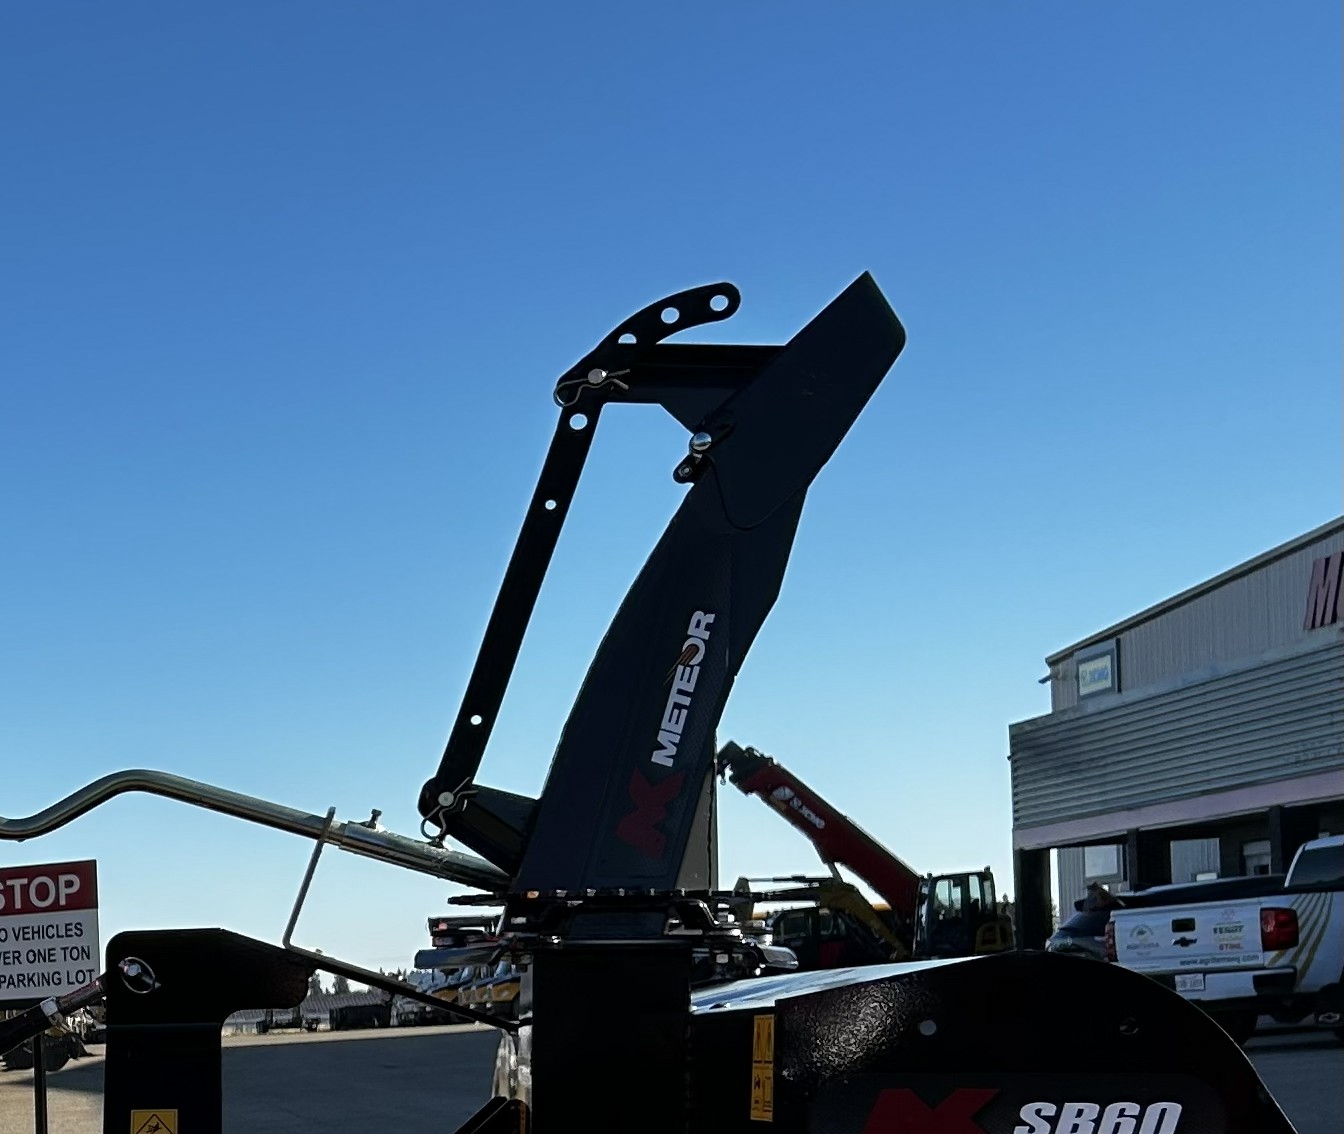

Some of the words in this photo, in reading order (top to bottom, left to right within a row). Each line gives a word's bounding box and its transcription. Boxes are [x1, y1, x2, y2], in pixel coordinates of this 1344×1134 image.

[651, 610, 716, 768] METEOR
[12, 922, 84, 942] VEHICLES
[26, 948, 56, 964] ONE
[60, 945, 90, 962] TON
[66, 969, 95, 986] LOT
